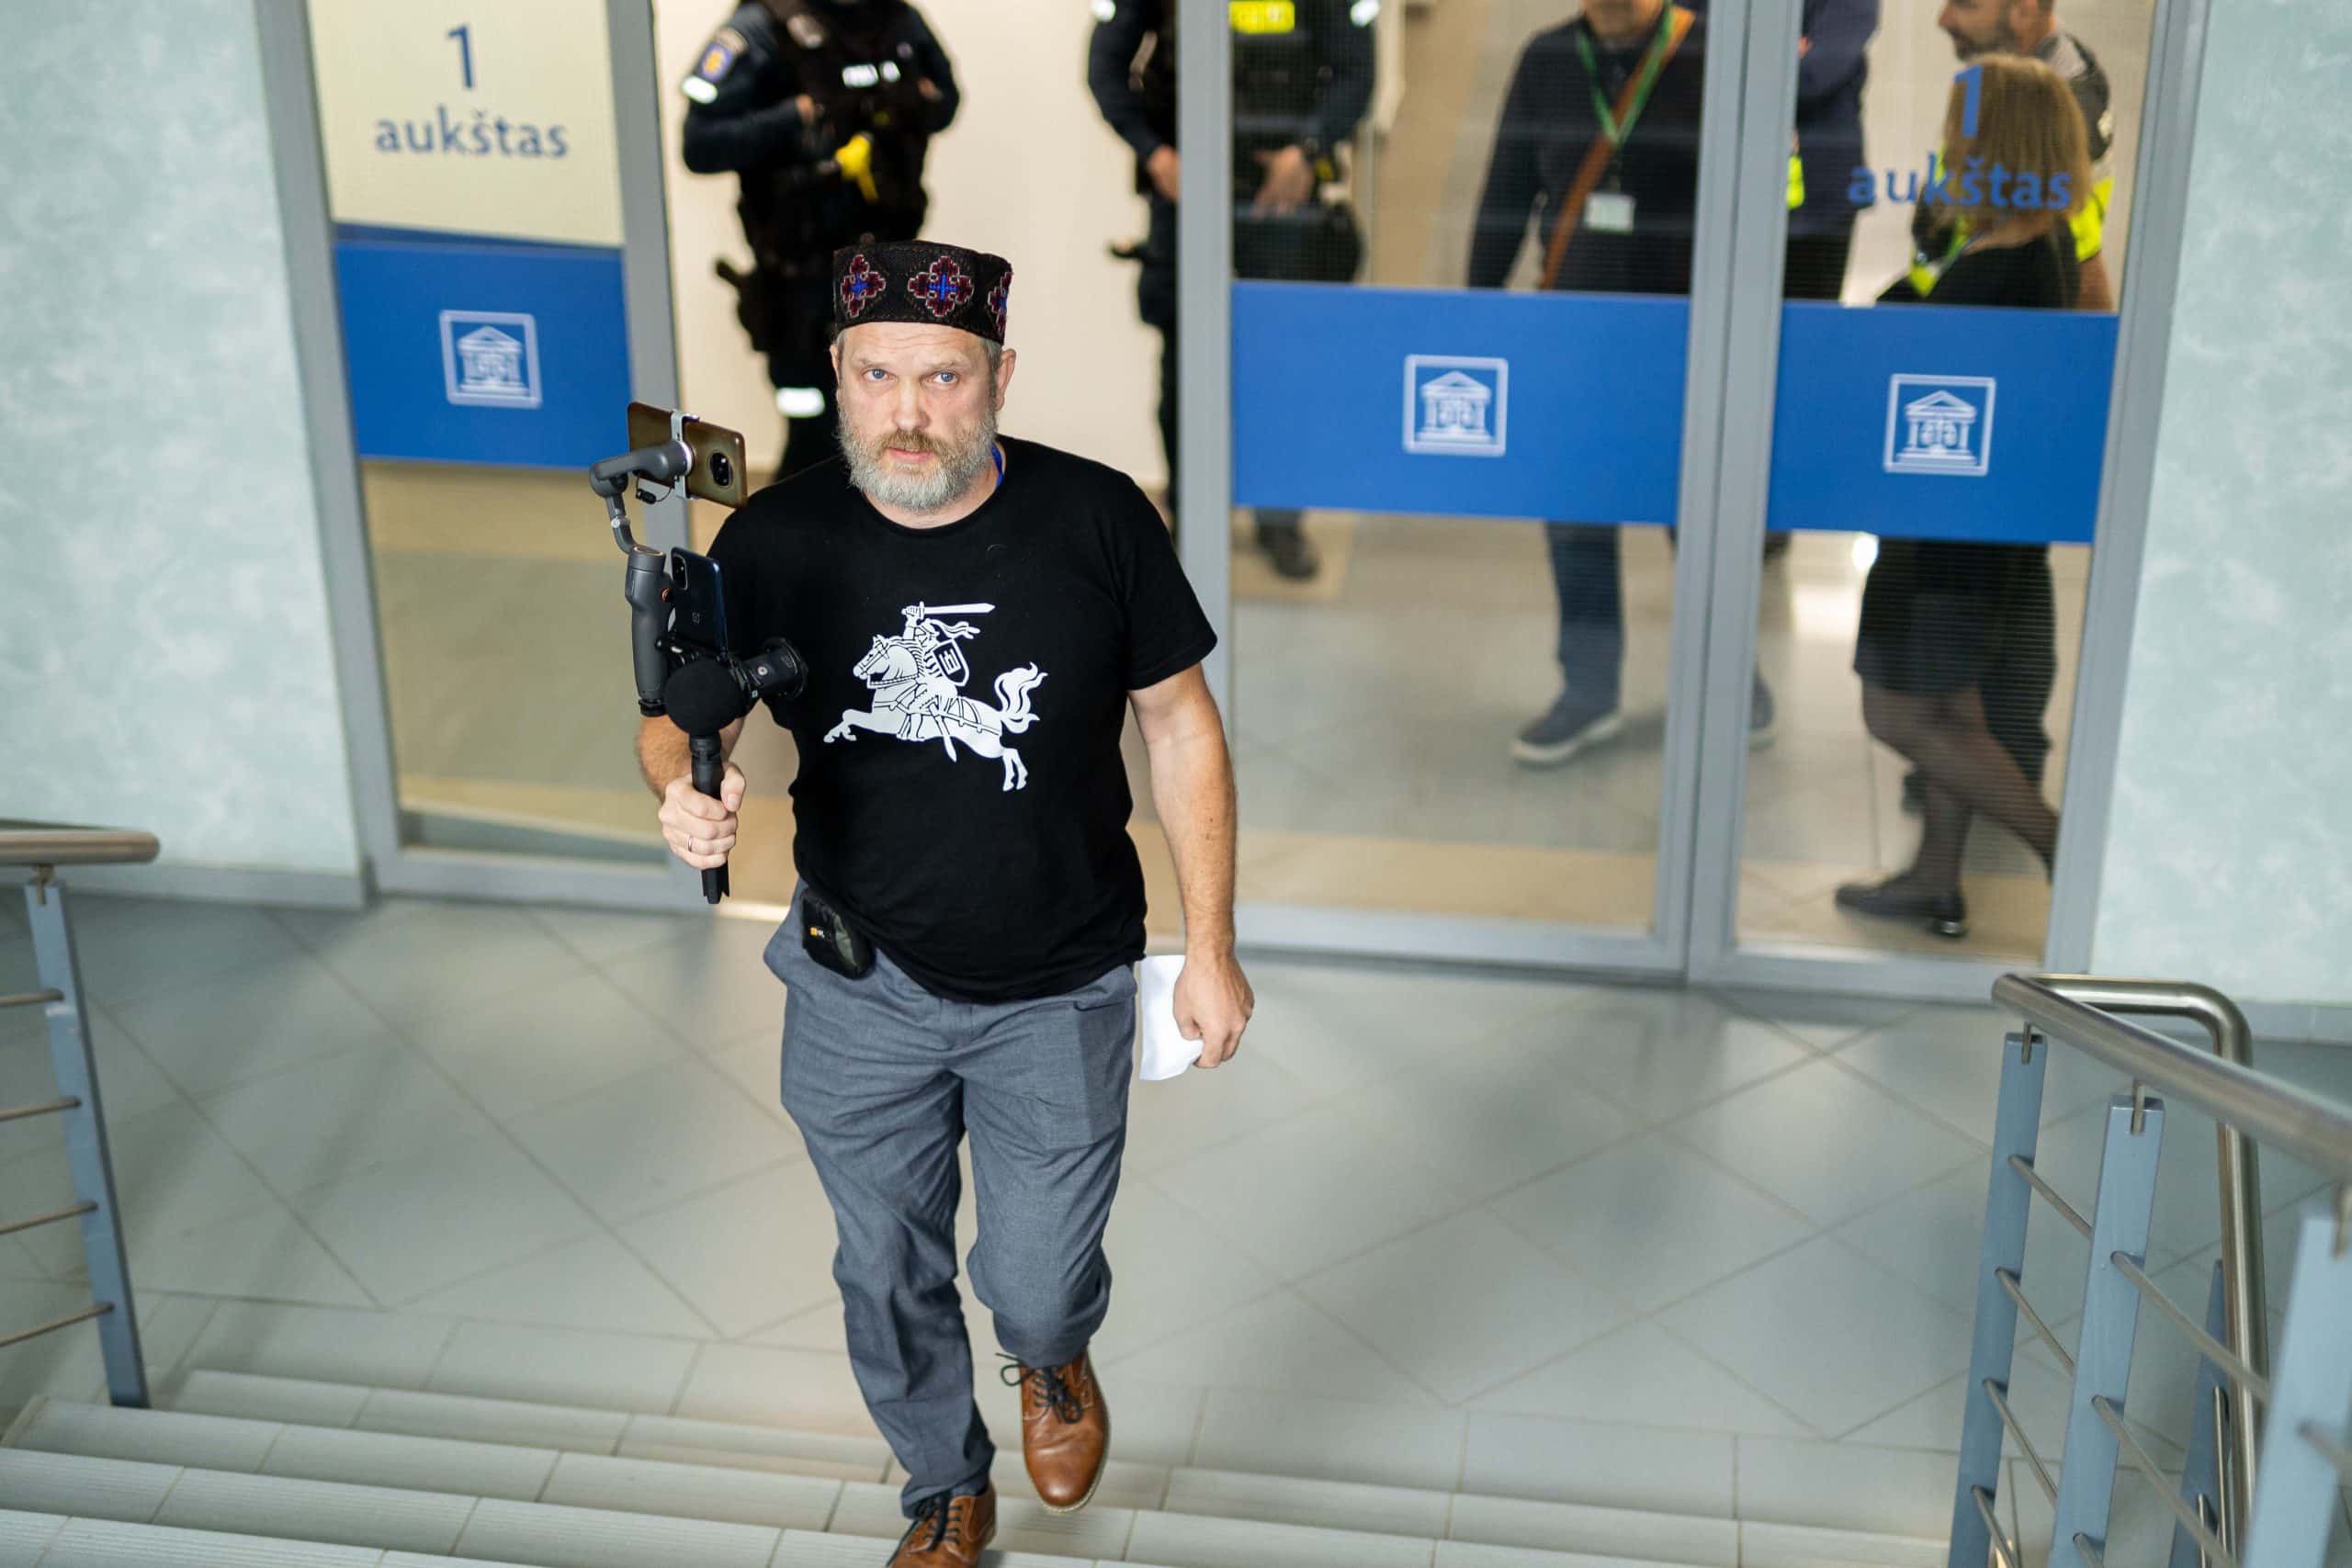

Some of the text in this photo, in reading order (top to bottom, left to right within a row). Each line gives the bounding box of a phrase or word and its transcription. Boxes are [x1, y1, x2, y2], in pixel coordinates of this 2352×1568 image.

[447, 24, 475, 90] 1
[375, 104, 569, 158] aukštas
[1954, 64, 1983, 137] 1
[1847, 152, 2073, 209] aukštas
